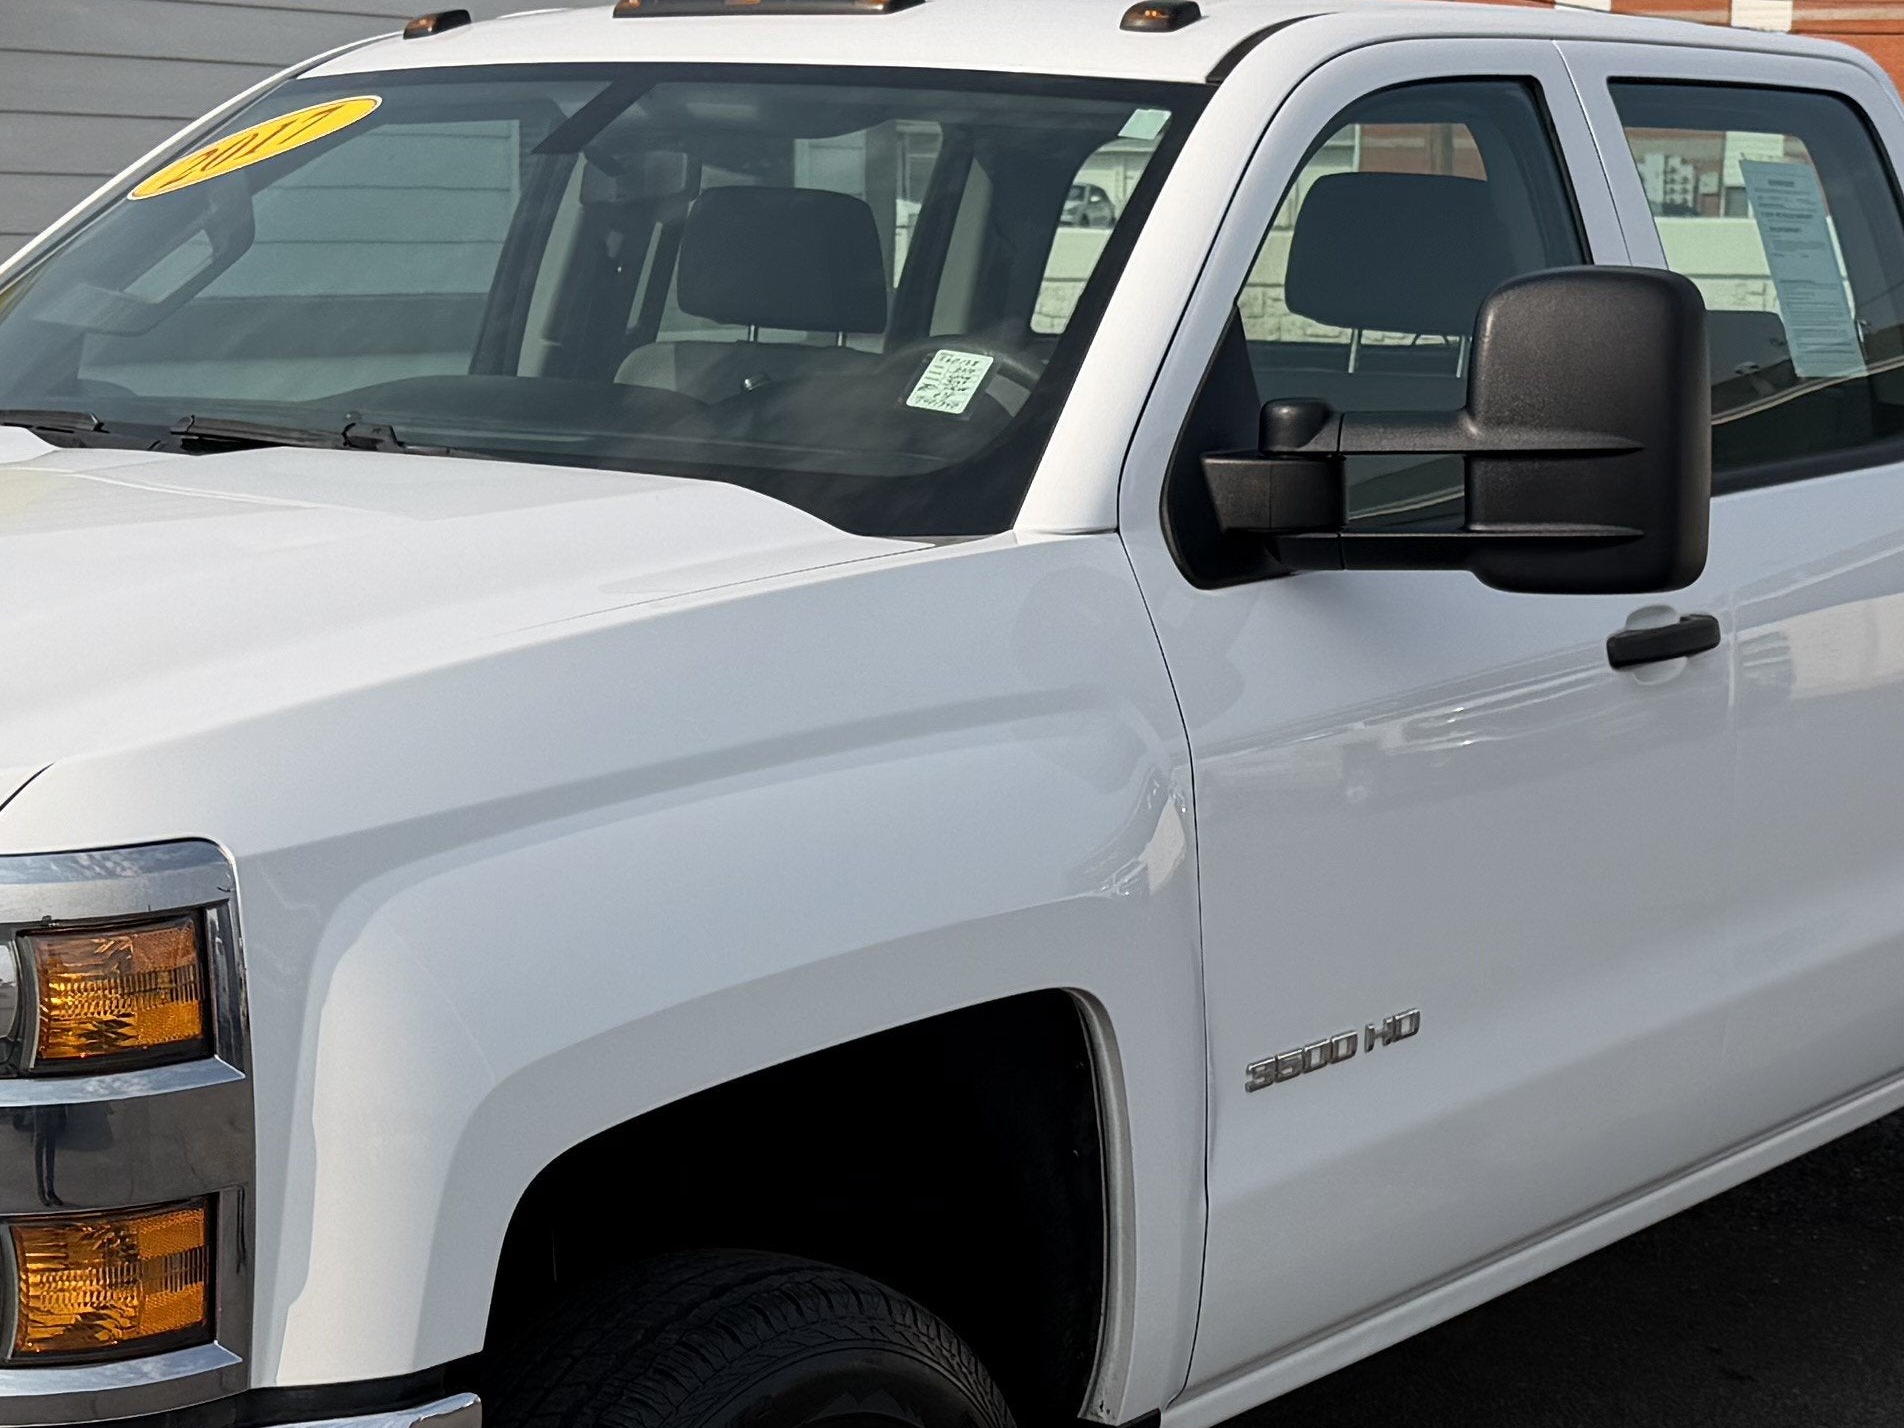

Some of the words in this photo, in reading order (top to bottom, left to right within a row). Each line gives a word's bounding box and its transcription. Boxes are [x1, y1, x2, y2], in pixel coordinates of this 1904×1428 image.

[156, 104, 345, 190] 2017
[1245, 1029, 1358, 1093] 3500
[1363, 1007, 1421, 1053] HD
